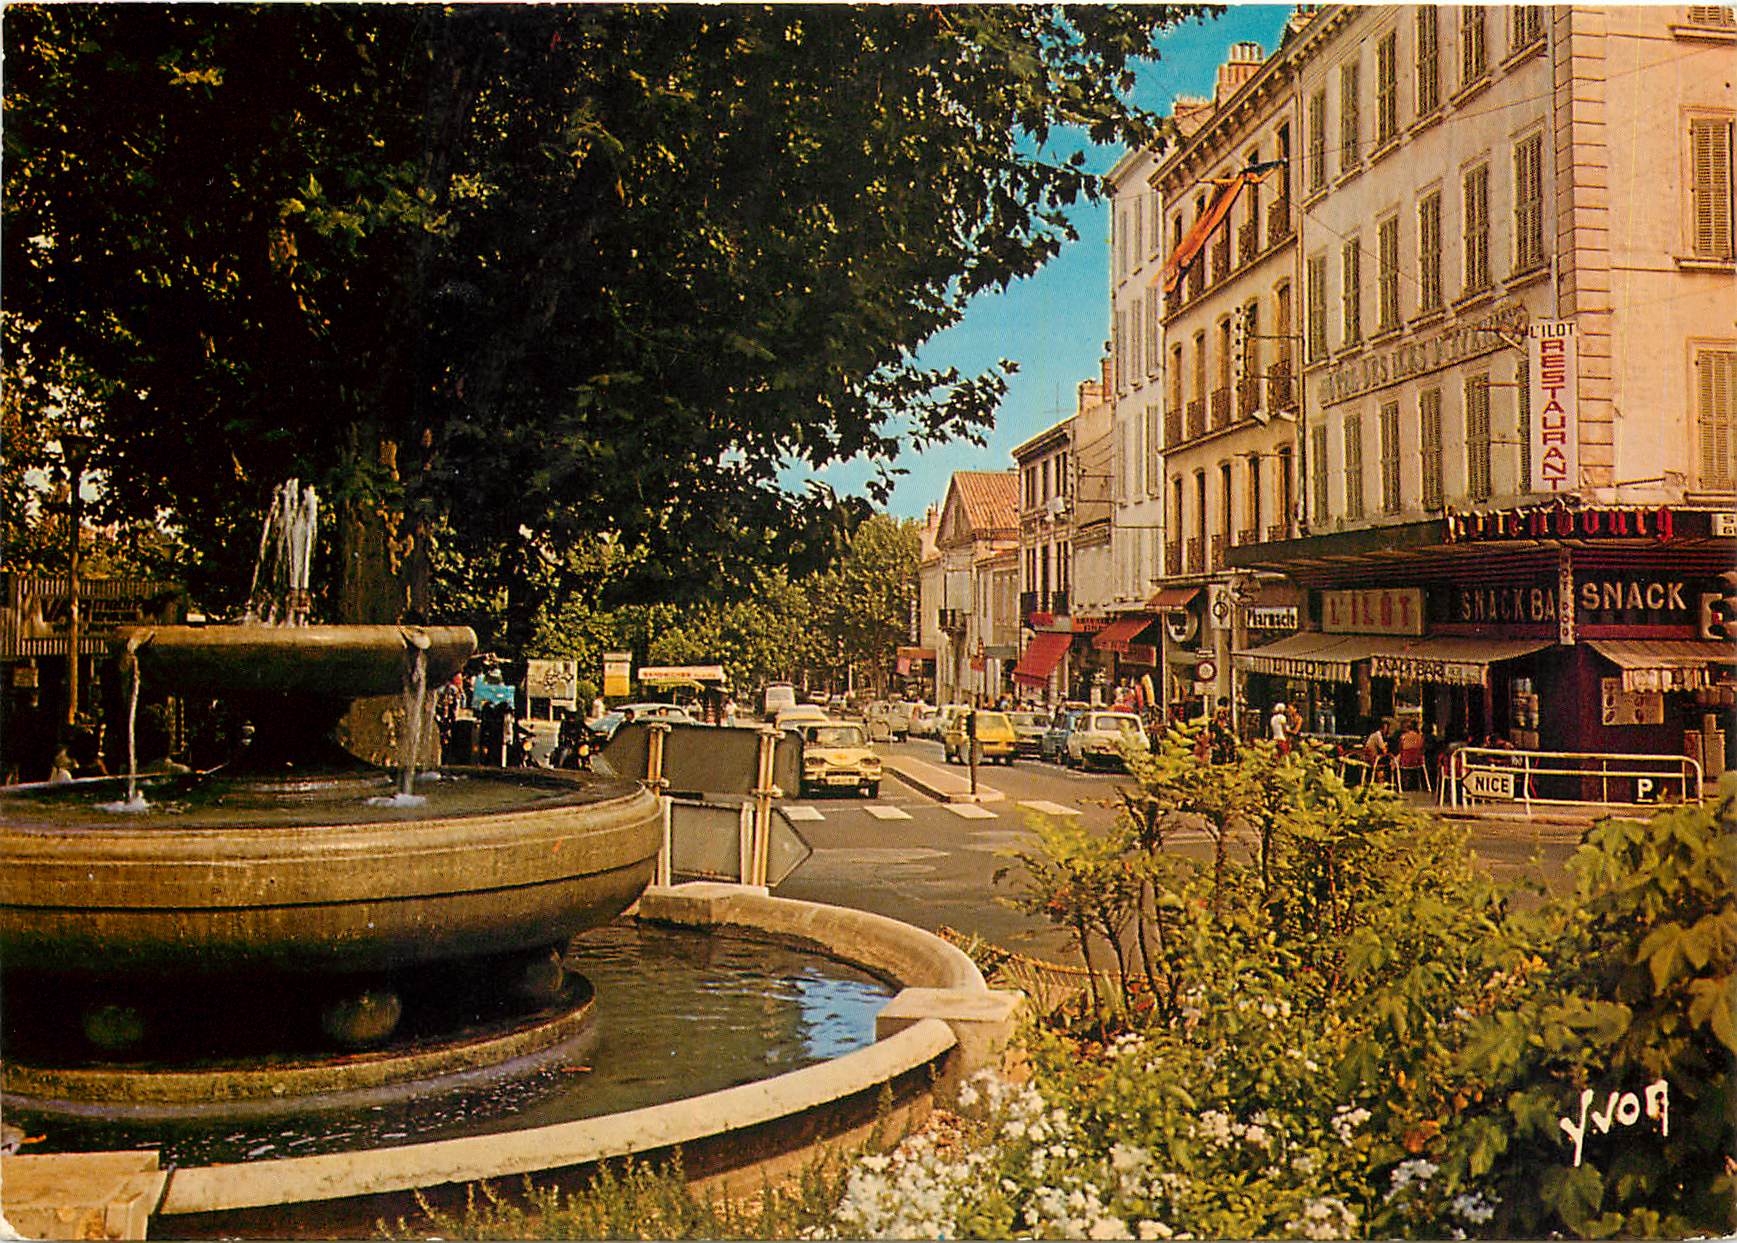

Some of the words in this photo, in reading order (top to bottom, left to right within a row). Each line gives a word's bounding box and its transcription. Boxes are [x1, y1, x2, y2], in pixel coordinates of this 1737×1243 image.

[1529, 322, 1575, 339] L'ILOT
[1540, 338, 1567, 491] RESTAURANT
[1461, 587, 1525, 621] SNACK
[1530, 587, 1556, 622] BA
[1581, 582, 1687, 610] SNACK
[1475, 777, 1510, 795] NICE
[1638, 778, 1653, 798] P
